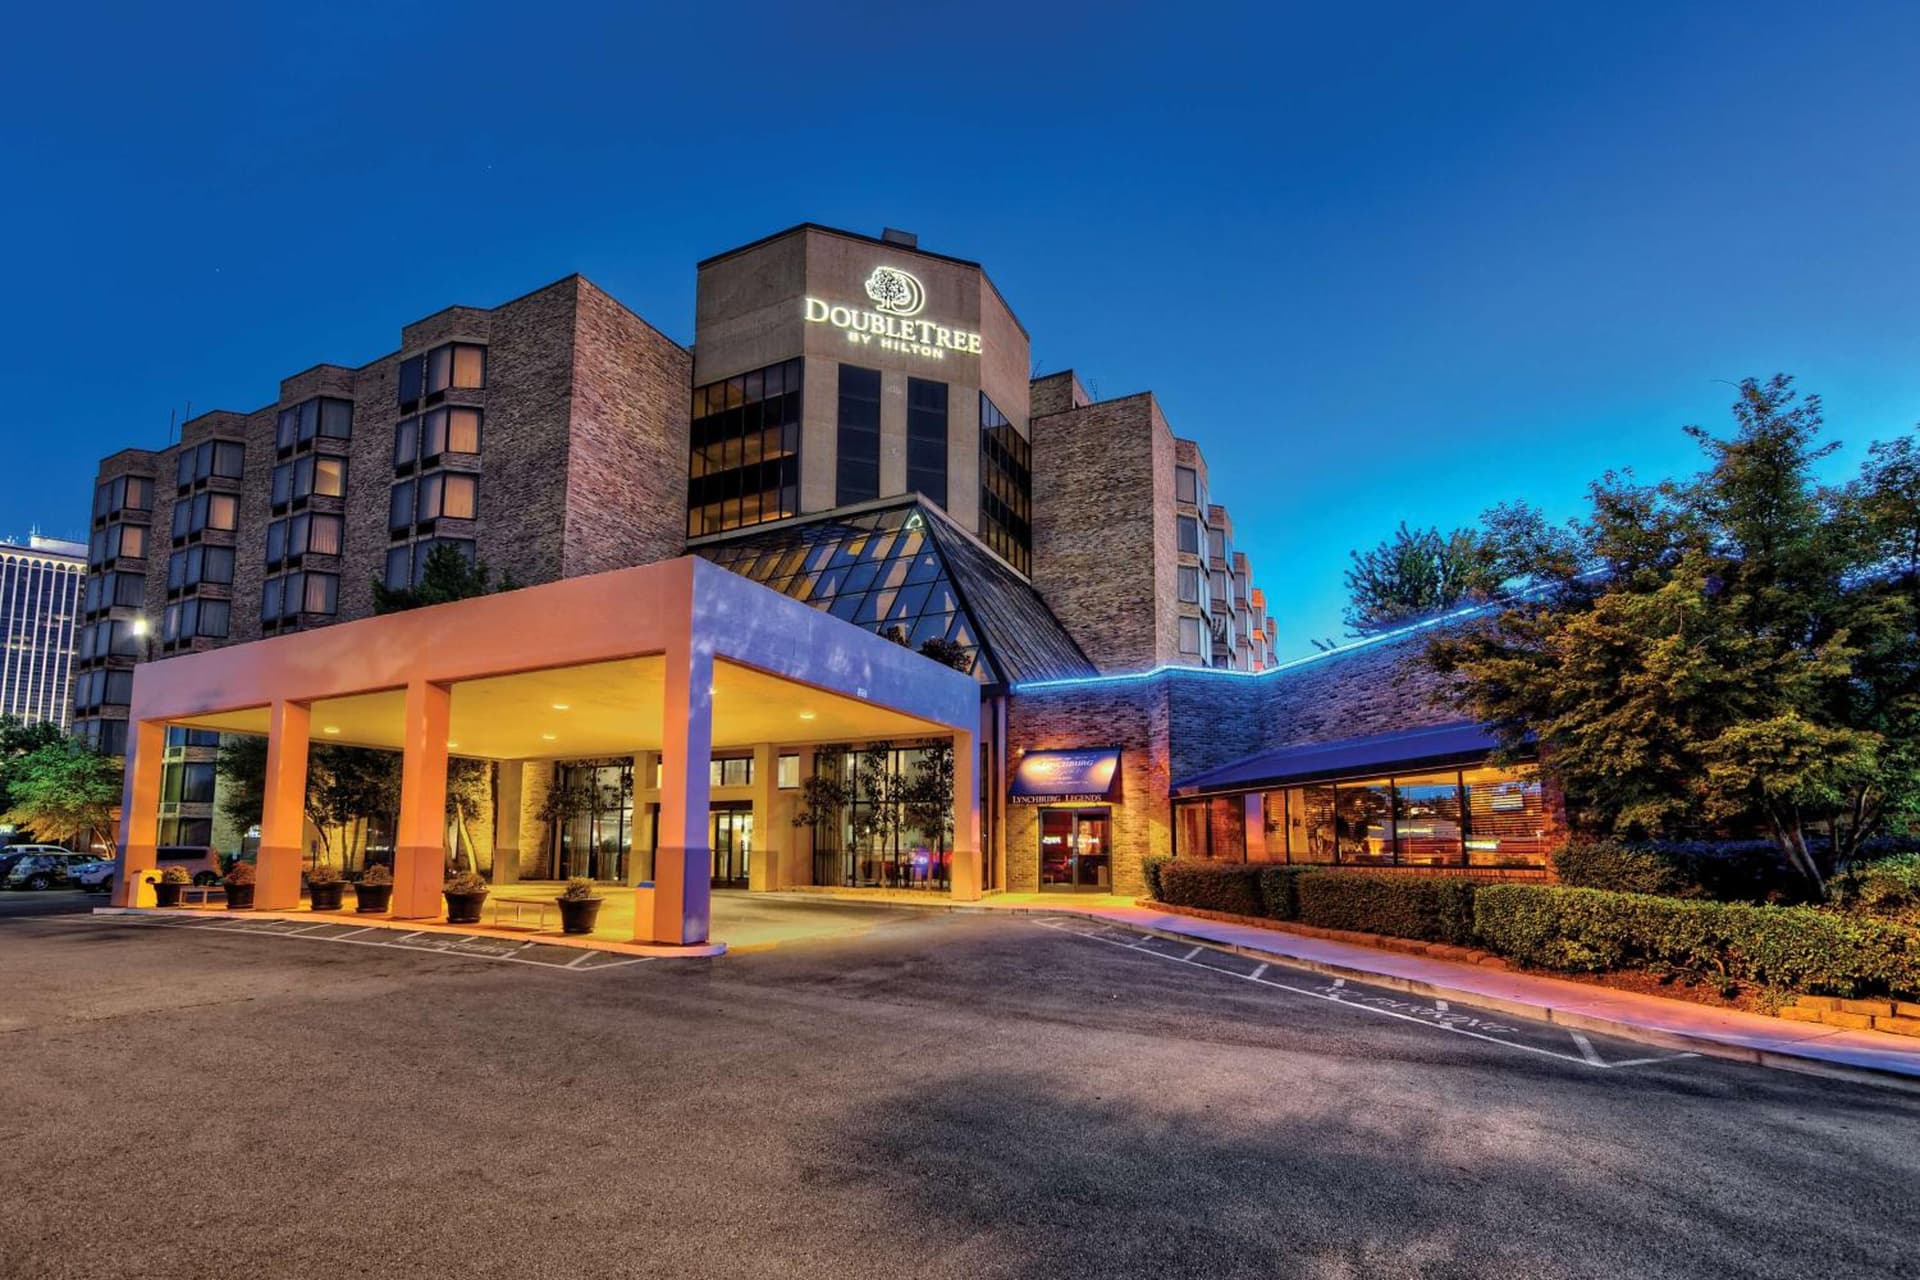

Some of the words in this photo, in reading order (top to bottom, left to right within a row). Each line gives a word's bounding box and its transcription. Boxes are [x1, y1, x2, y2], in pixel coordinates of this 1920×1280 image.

[804, 298, 983, 355] DOUBLETREE
[848, 331, 871, 345] BY
[881, 339, 943, 359] HILTON
[1065, 794, 1102, 802] LEGENDS
